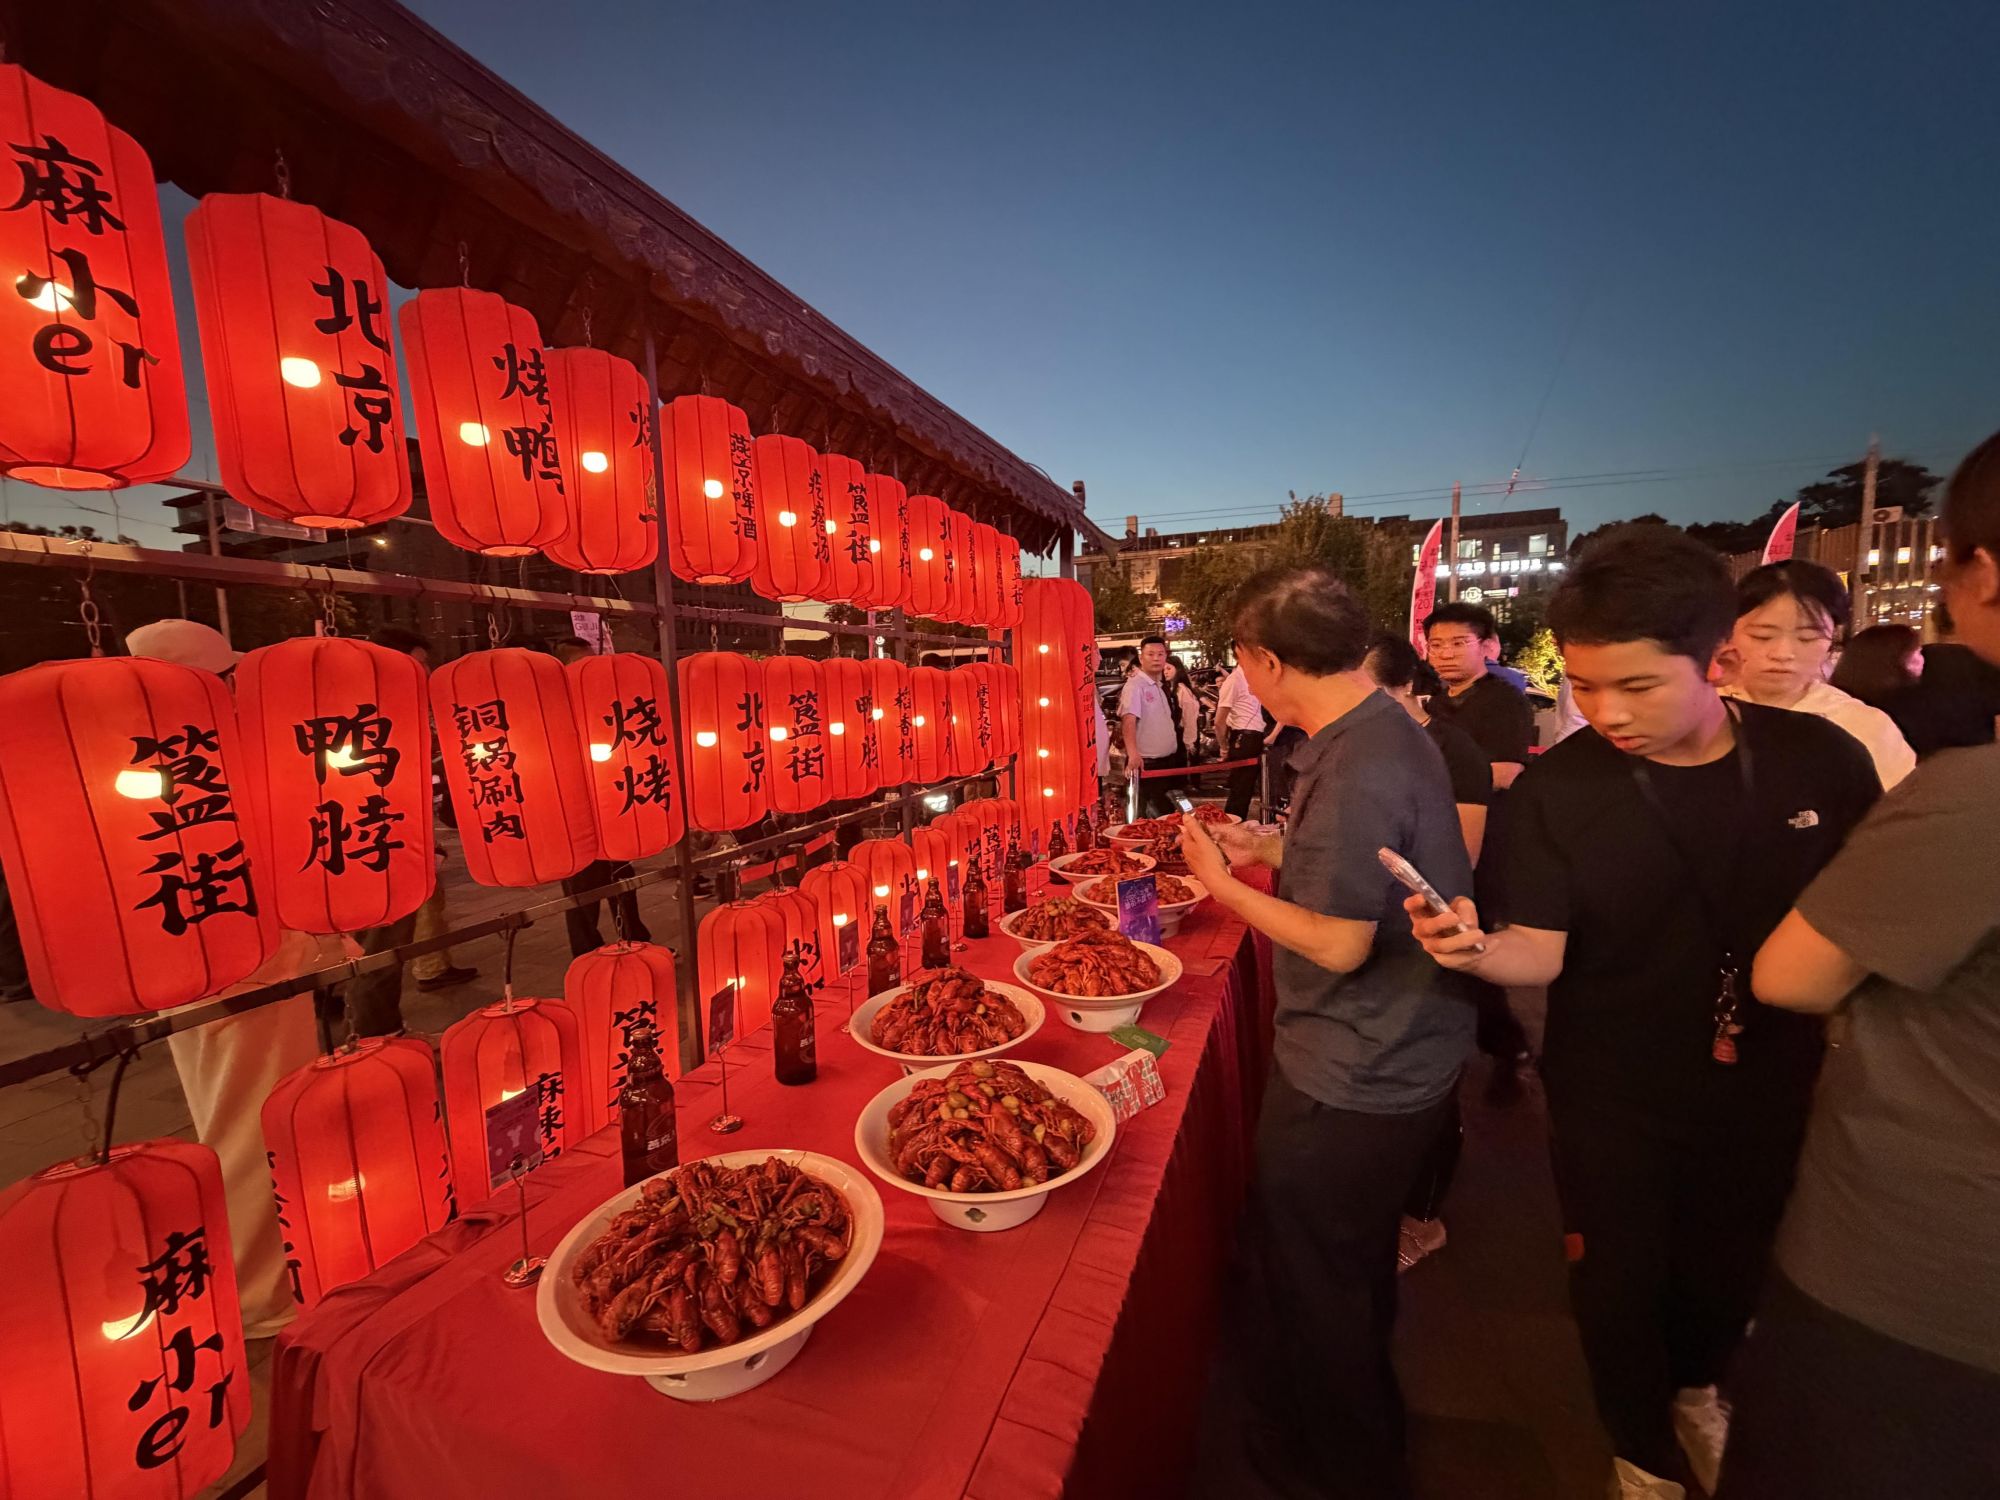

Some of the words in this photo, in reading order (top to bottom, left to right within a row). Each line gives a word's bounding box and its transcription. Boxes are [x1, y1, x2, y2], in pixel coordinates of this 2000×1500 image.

[309, 266, 394, 454] 北京
[492, 343, 566, 495] 烤鸭
[729, 432, 758, 541] 燕京啤酒
[293, 703, 405, 876] 鸭脖
[451, 699, 526, 844] 铜锅涮肉
[602, 695, 672, 818] 烧烤
[736, 691, 767, 793] 北京
[783, 689, 825, 784] 簋街
[893, 685, 914, 761] 稻香村
[132, 724, 259, 936] 簋街
